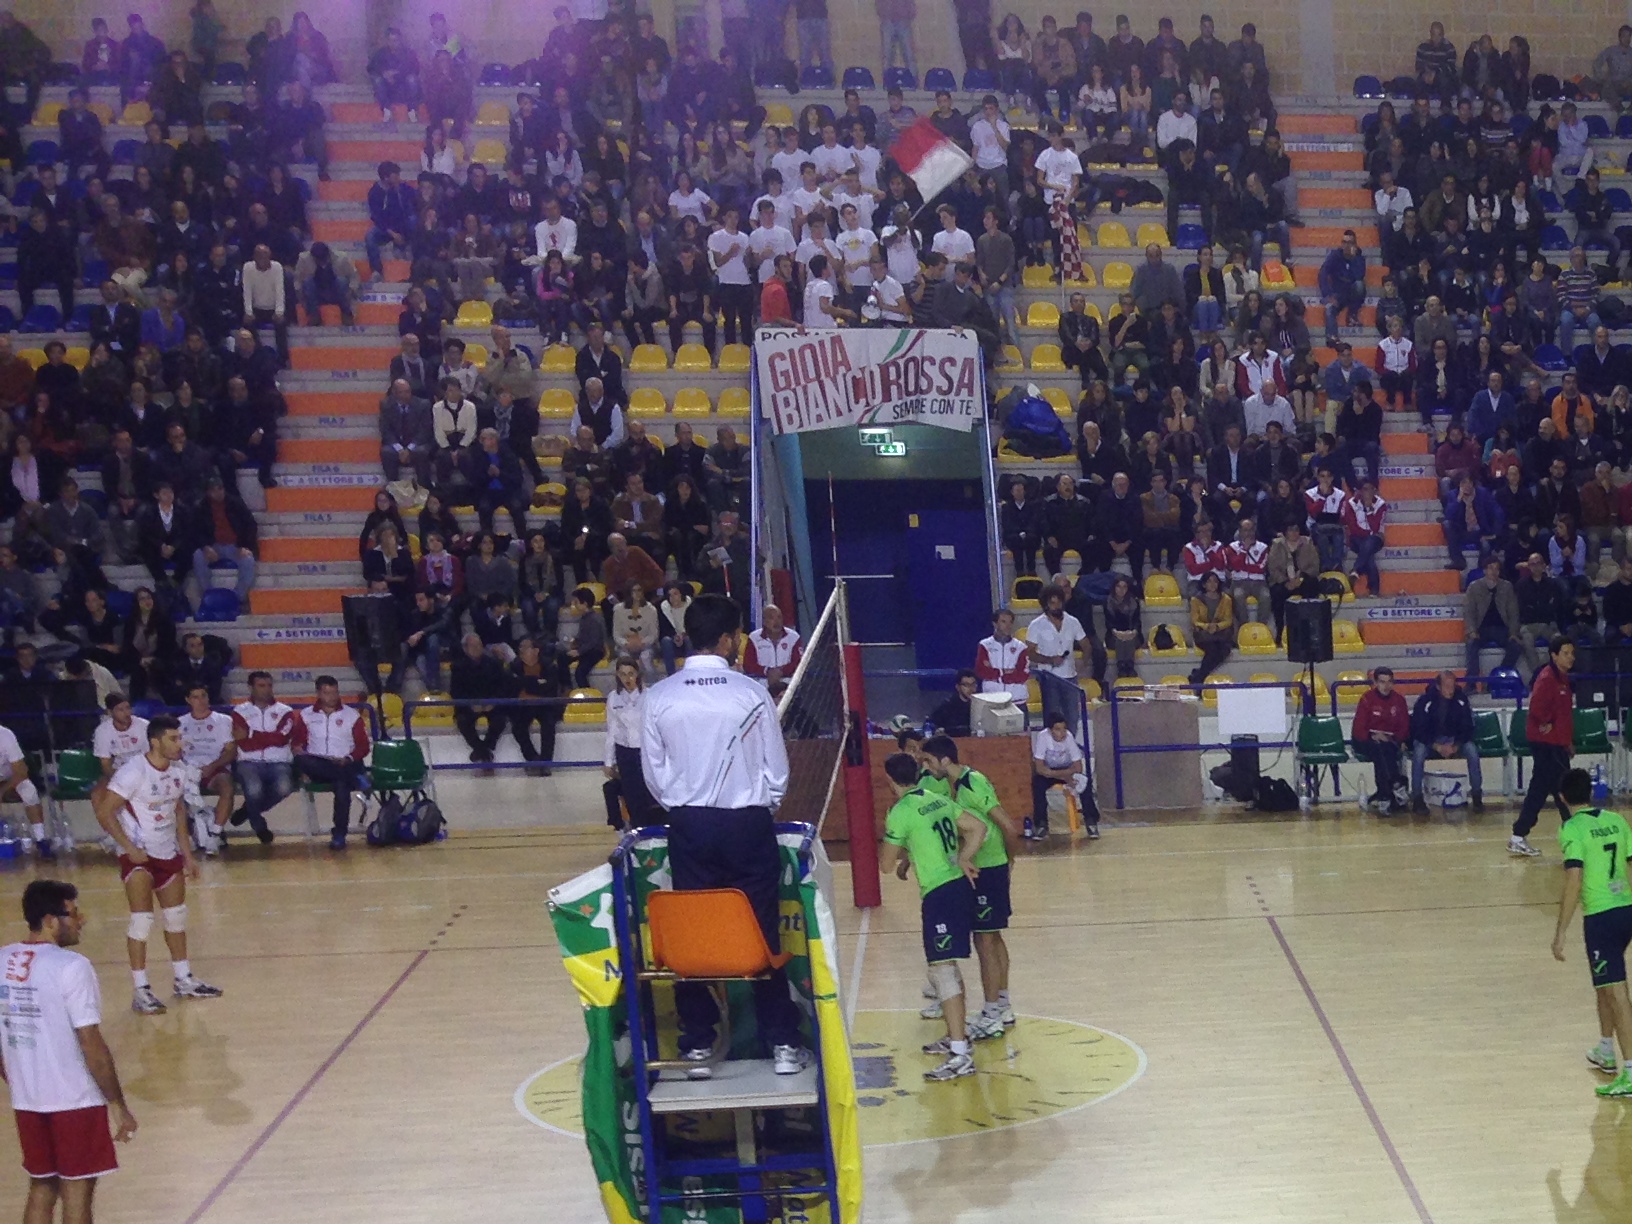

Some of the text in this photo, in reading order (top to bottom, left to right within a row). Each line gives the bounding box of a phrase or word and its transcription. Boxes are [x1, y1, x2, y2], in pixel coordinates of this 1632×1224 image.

[768, 334, 852, 393] GIOIA
[930, 397, 958, 415] CON
[959, 399, 973, 415] TE
[285, 630, 334, 638] SETTORE
[697, 676, 728, 686] errea
[932, 816, 957, 853] 18
[1603, 842, 1617, 879] 7
